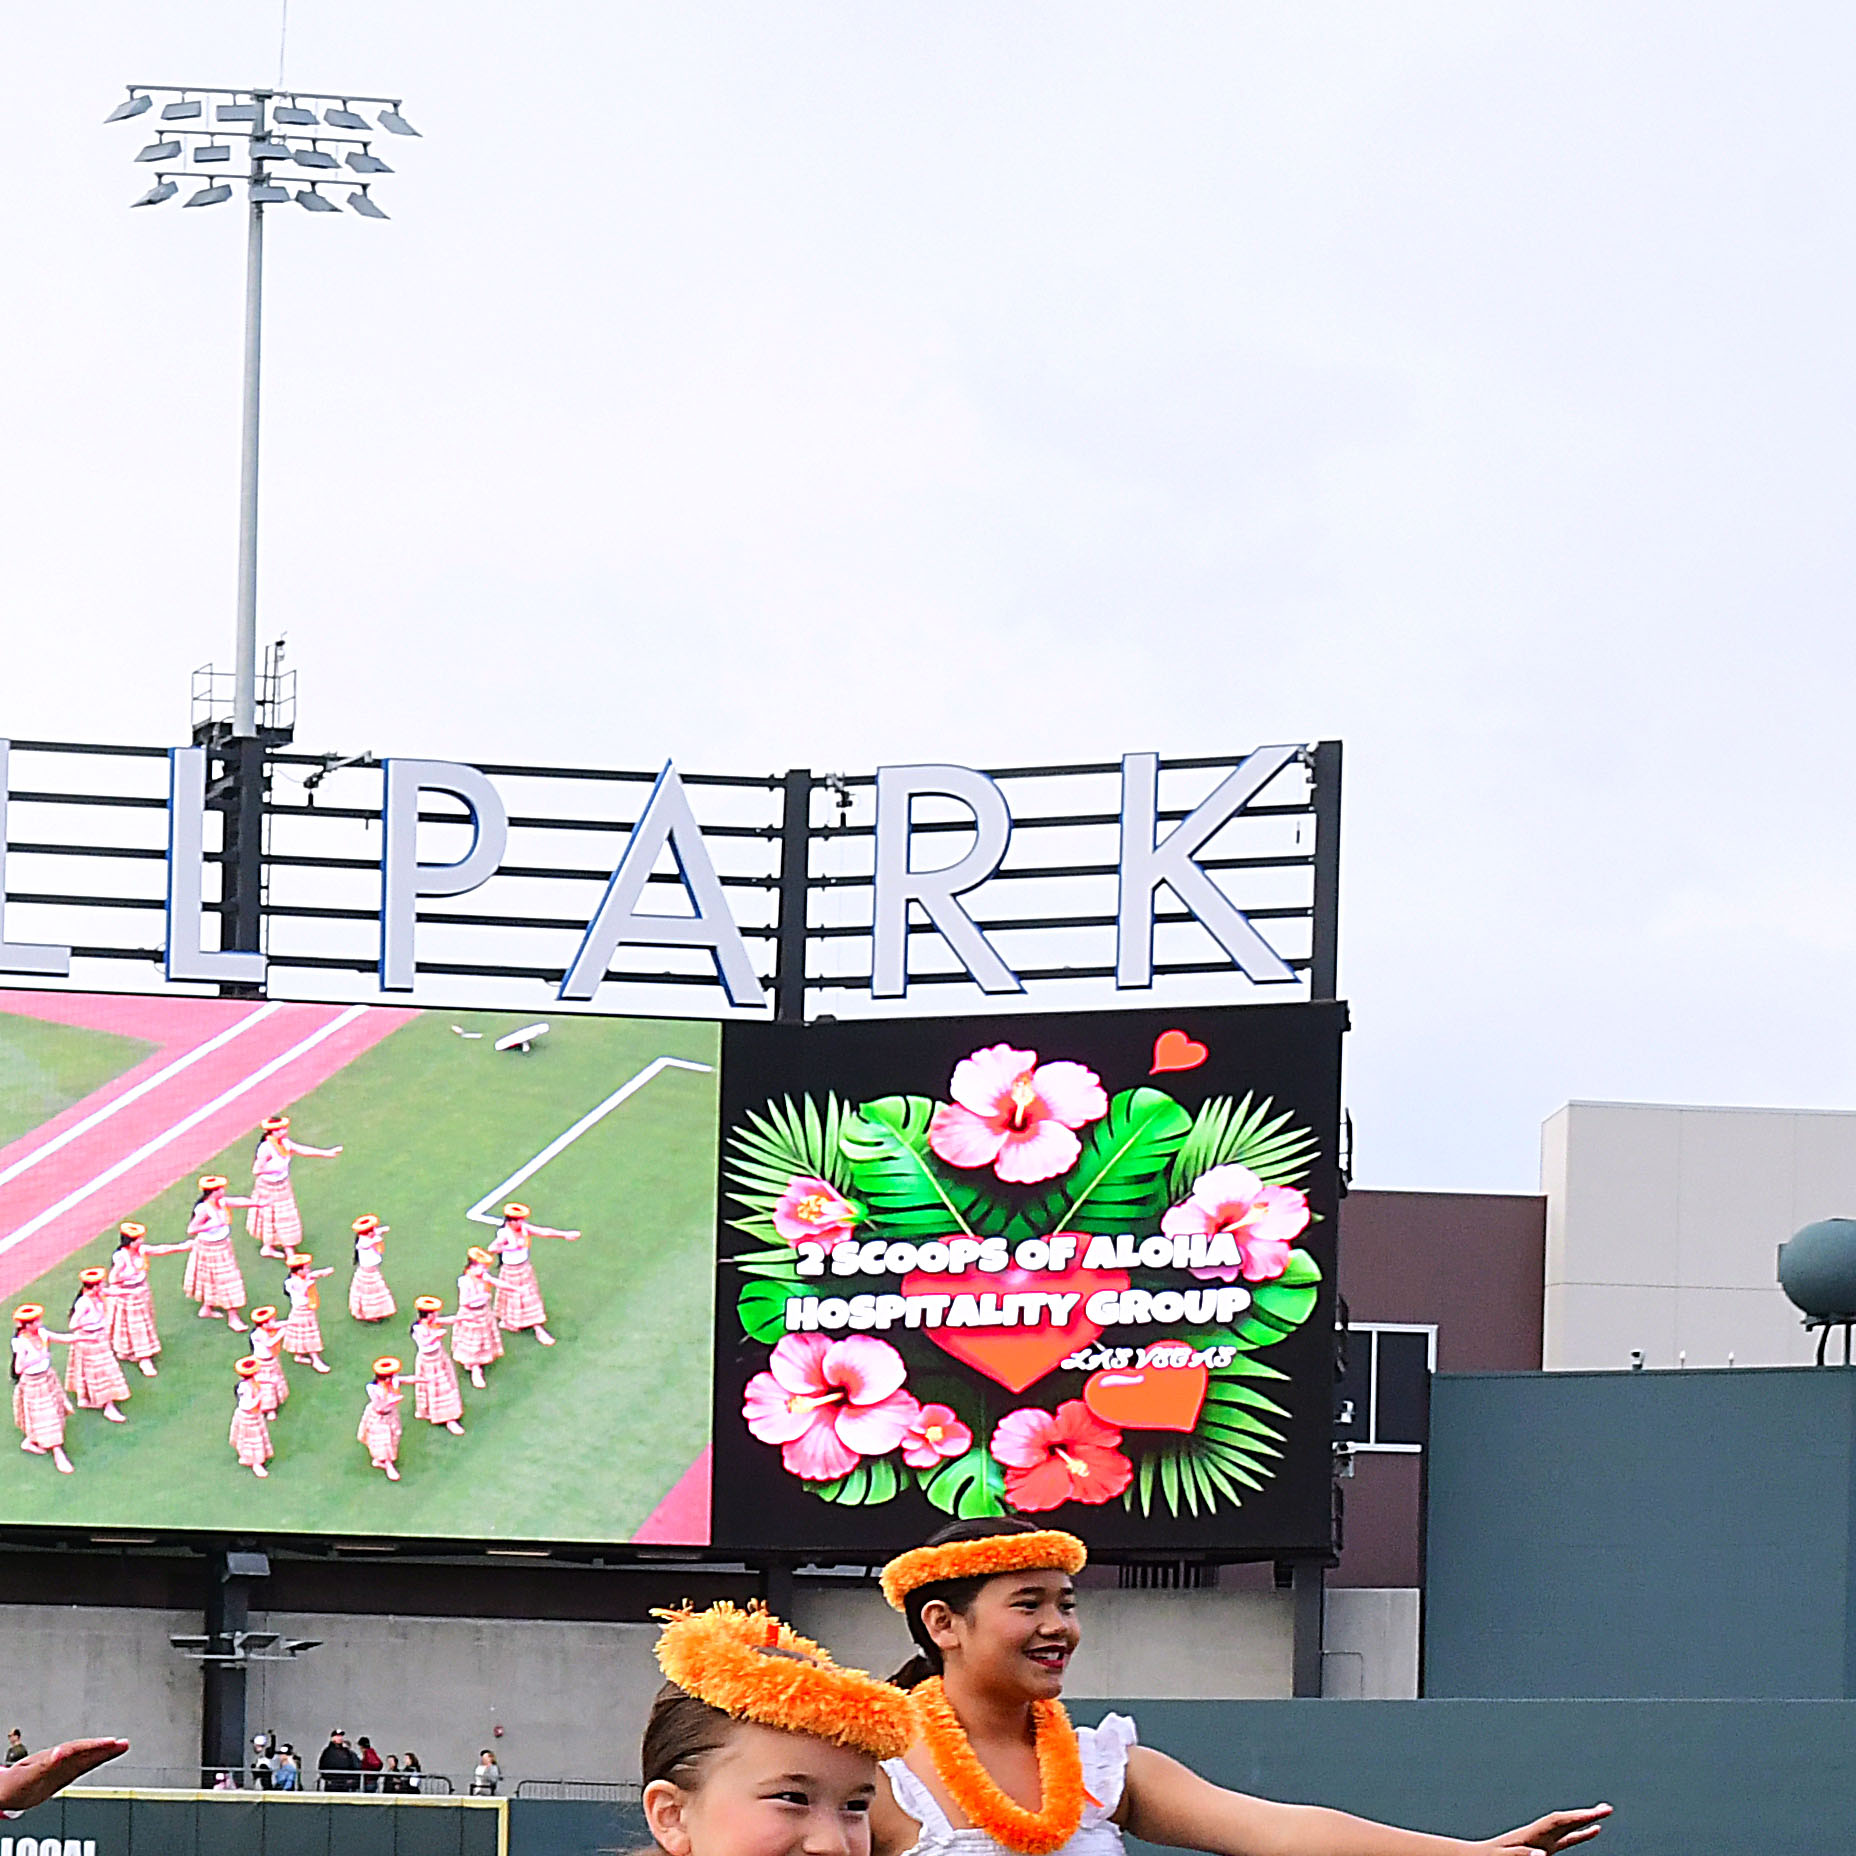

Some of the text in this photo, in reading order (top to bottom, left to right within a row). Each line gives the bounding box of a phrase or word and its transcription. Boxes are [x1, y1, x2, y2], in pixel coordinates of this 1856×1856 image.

[795, 1232, 1242, 1277] 2 SCOOPS OF ALOHA
[784, 1287, 1252, 1332] HOSPITALITY GROUP
